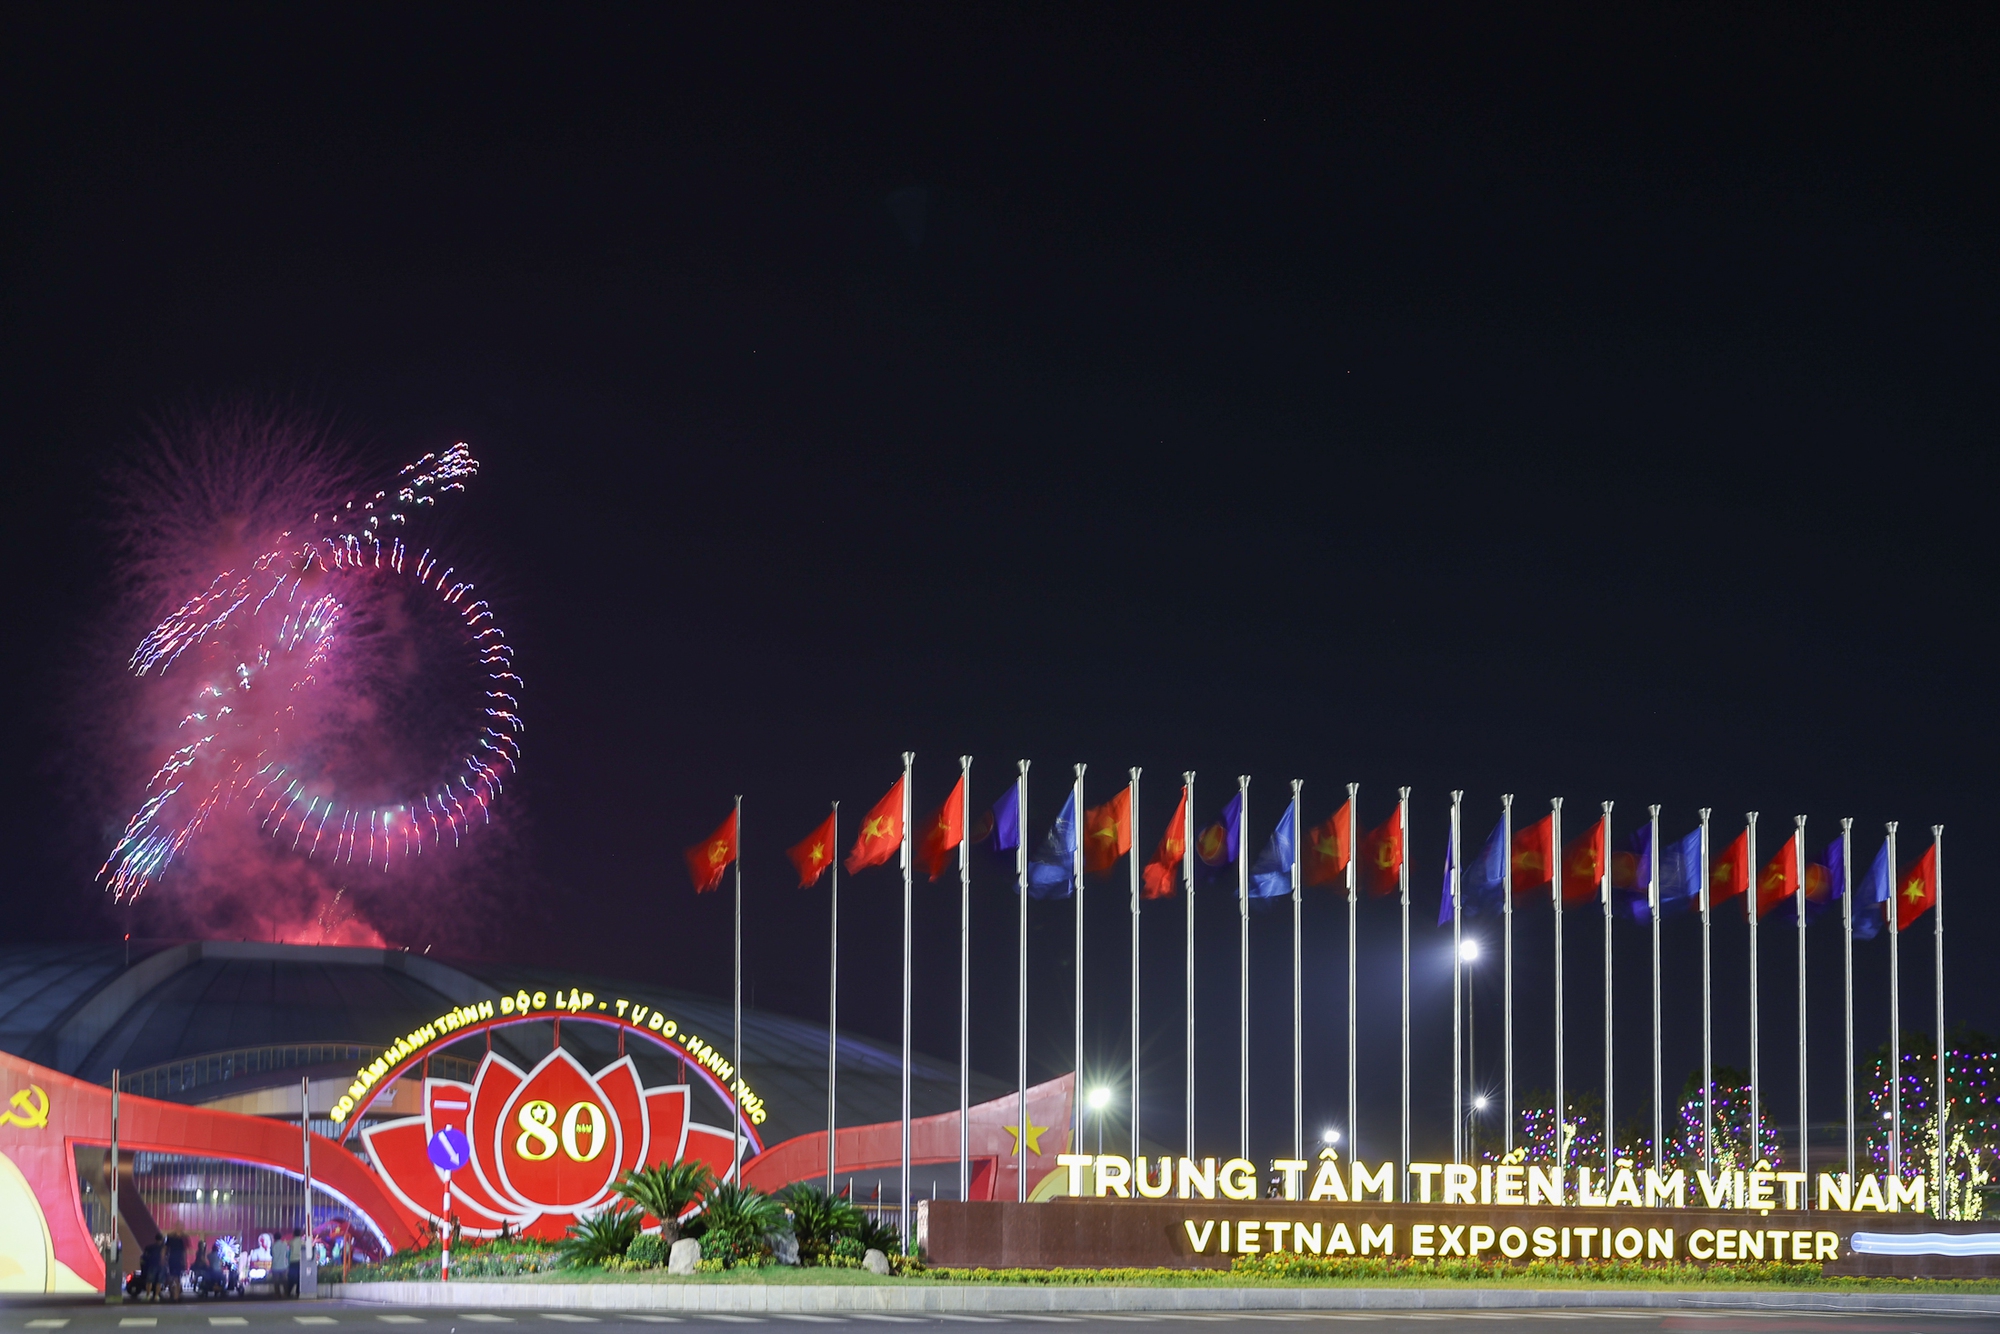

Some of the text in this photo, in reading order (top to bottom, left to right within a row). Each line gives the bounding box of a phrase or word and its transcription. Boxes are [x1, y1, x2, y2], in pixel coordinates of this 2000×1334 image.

[330, 1095, 354, 1124] 80
[348, 1067, 389, 1101] NĂM
[384, 1023, 437, 1067] HÀNH
[433, 1000, 495, 1035] TRÌNH
[500, 989, 548, 1017] ĐỘC
[555, 988, 595, 1014] LẬP
[648, 1011, 678, 1038] DO
[685, 1035, 734, 1082] HẠNH
[515, 1099, 607, 1162] 80
[1057, 1147, 1926, 1216] TRUNG TÂM TRIỂN LÃM VIỆT NAM
[1184, 1219, 1840, 1261] VIETNAM EXPOSITION CENTER
